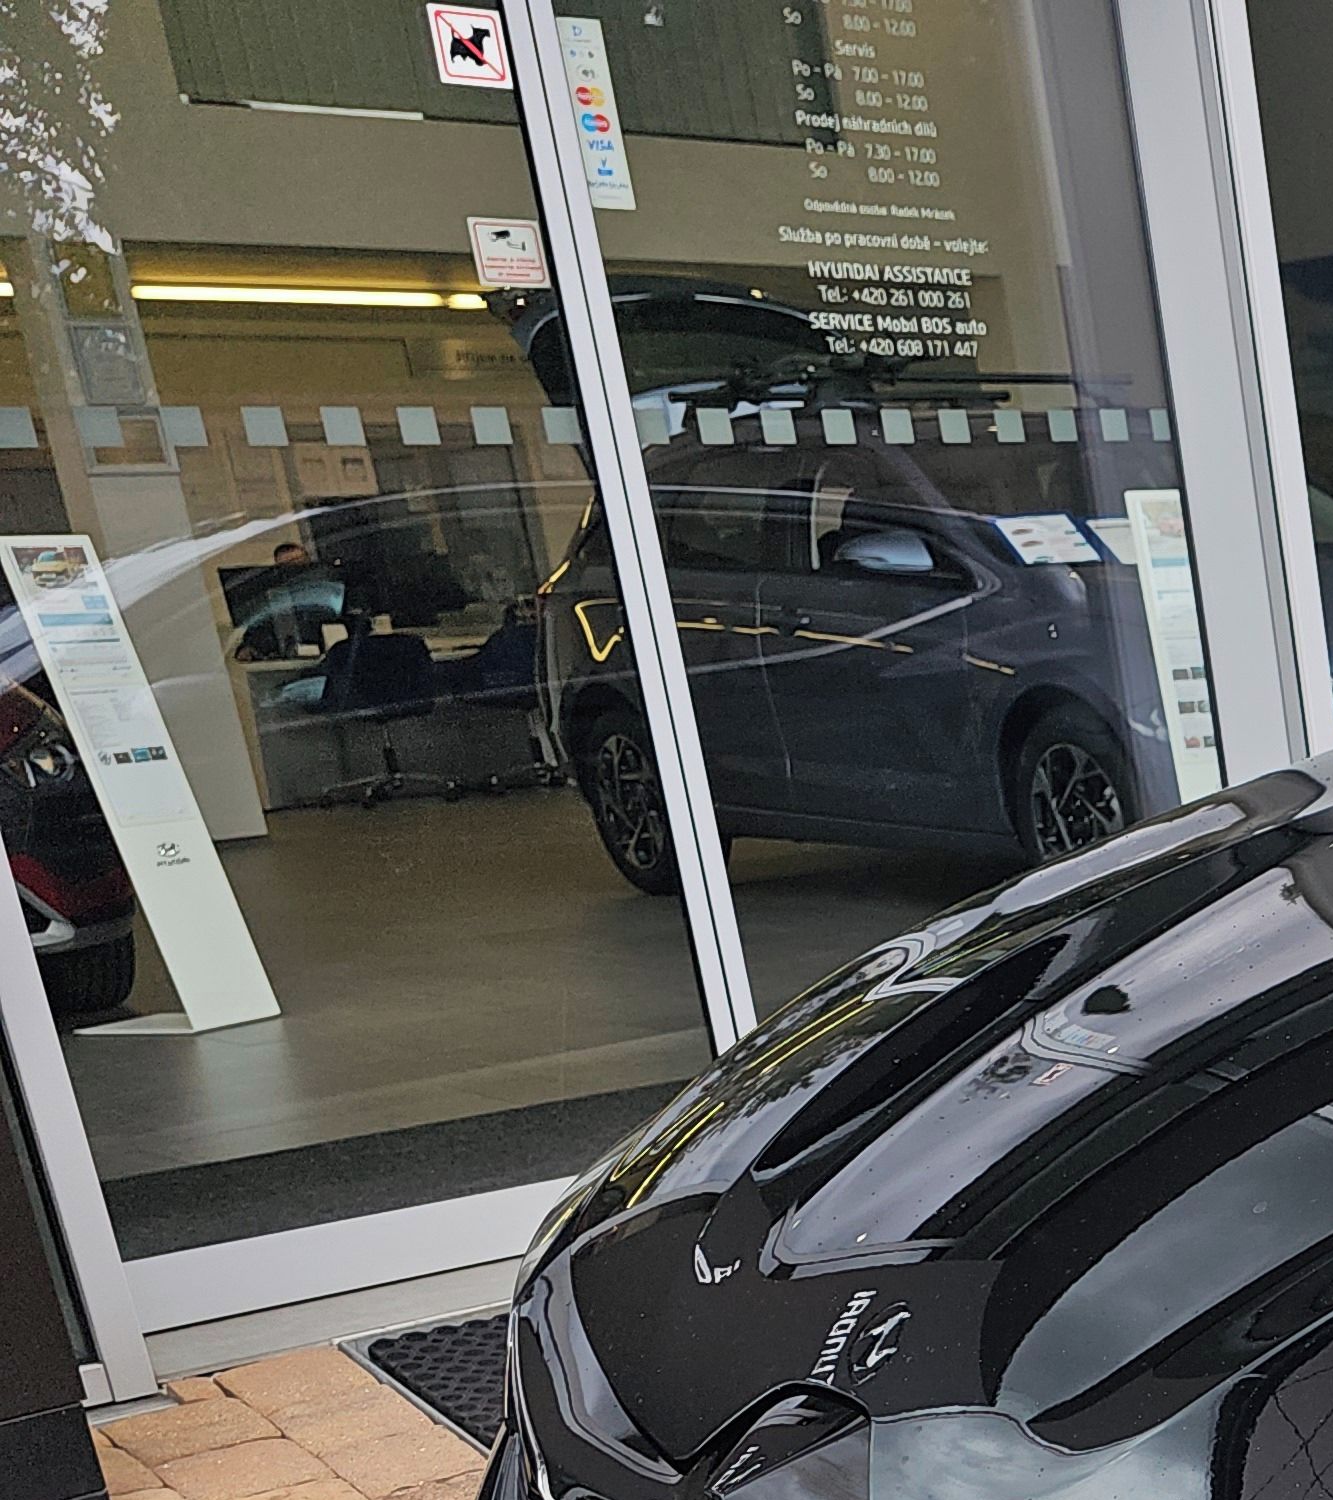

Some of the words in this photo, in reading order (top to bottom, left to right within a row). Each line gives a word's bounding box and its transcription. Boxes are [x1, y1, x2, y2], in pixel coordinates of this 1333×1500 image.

[783, 7, 802, 25] So
[835, 40, 876, 58] Servis
[792, 59, 811, 77] Po
[795, 83, 815, 101] So
[795, 109, 840, 132] Prodej
[588, 139, 614, 151] VISA
[805, 138, 824, 154] Po
[809, 161, 828, 178] So
[778, 226, 822, 244] Služba
[825, 232, 841, 246] po
[844, 231, 898, 248] pracovní
[807, 260, 879, 281] HYUNDAI
[883, 266, 972, 286] ASSISTANCE
[852, 287, 887, 305] +420
[890, 288, 914, 307] 261
[917, 290, 944, 308] 000
[946, 291, 971, 309] 261
[808, 311, 874, 332] SERVICE
[876, 315, 918, 333] Mobil
[921, 317, 952, 334] BOS
[955, 320, 986, 336] auto
[860, 337, 894, 356] +420
[926, 340, 949, 357] 171
[954, 340, 978, 358] 447
